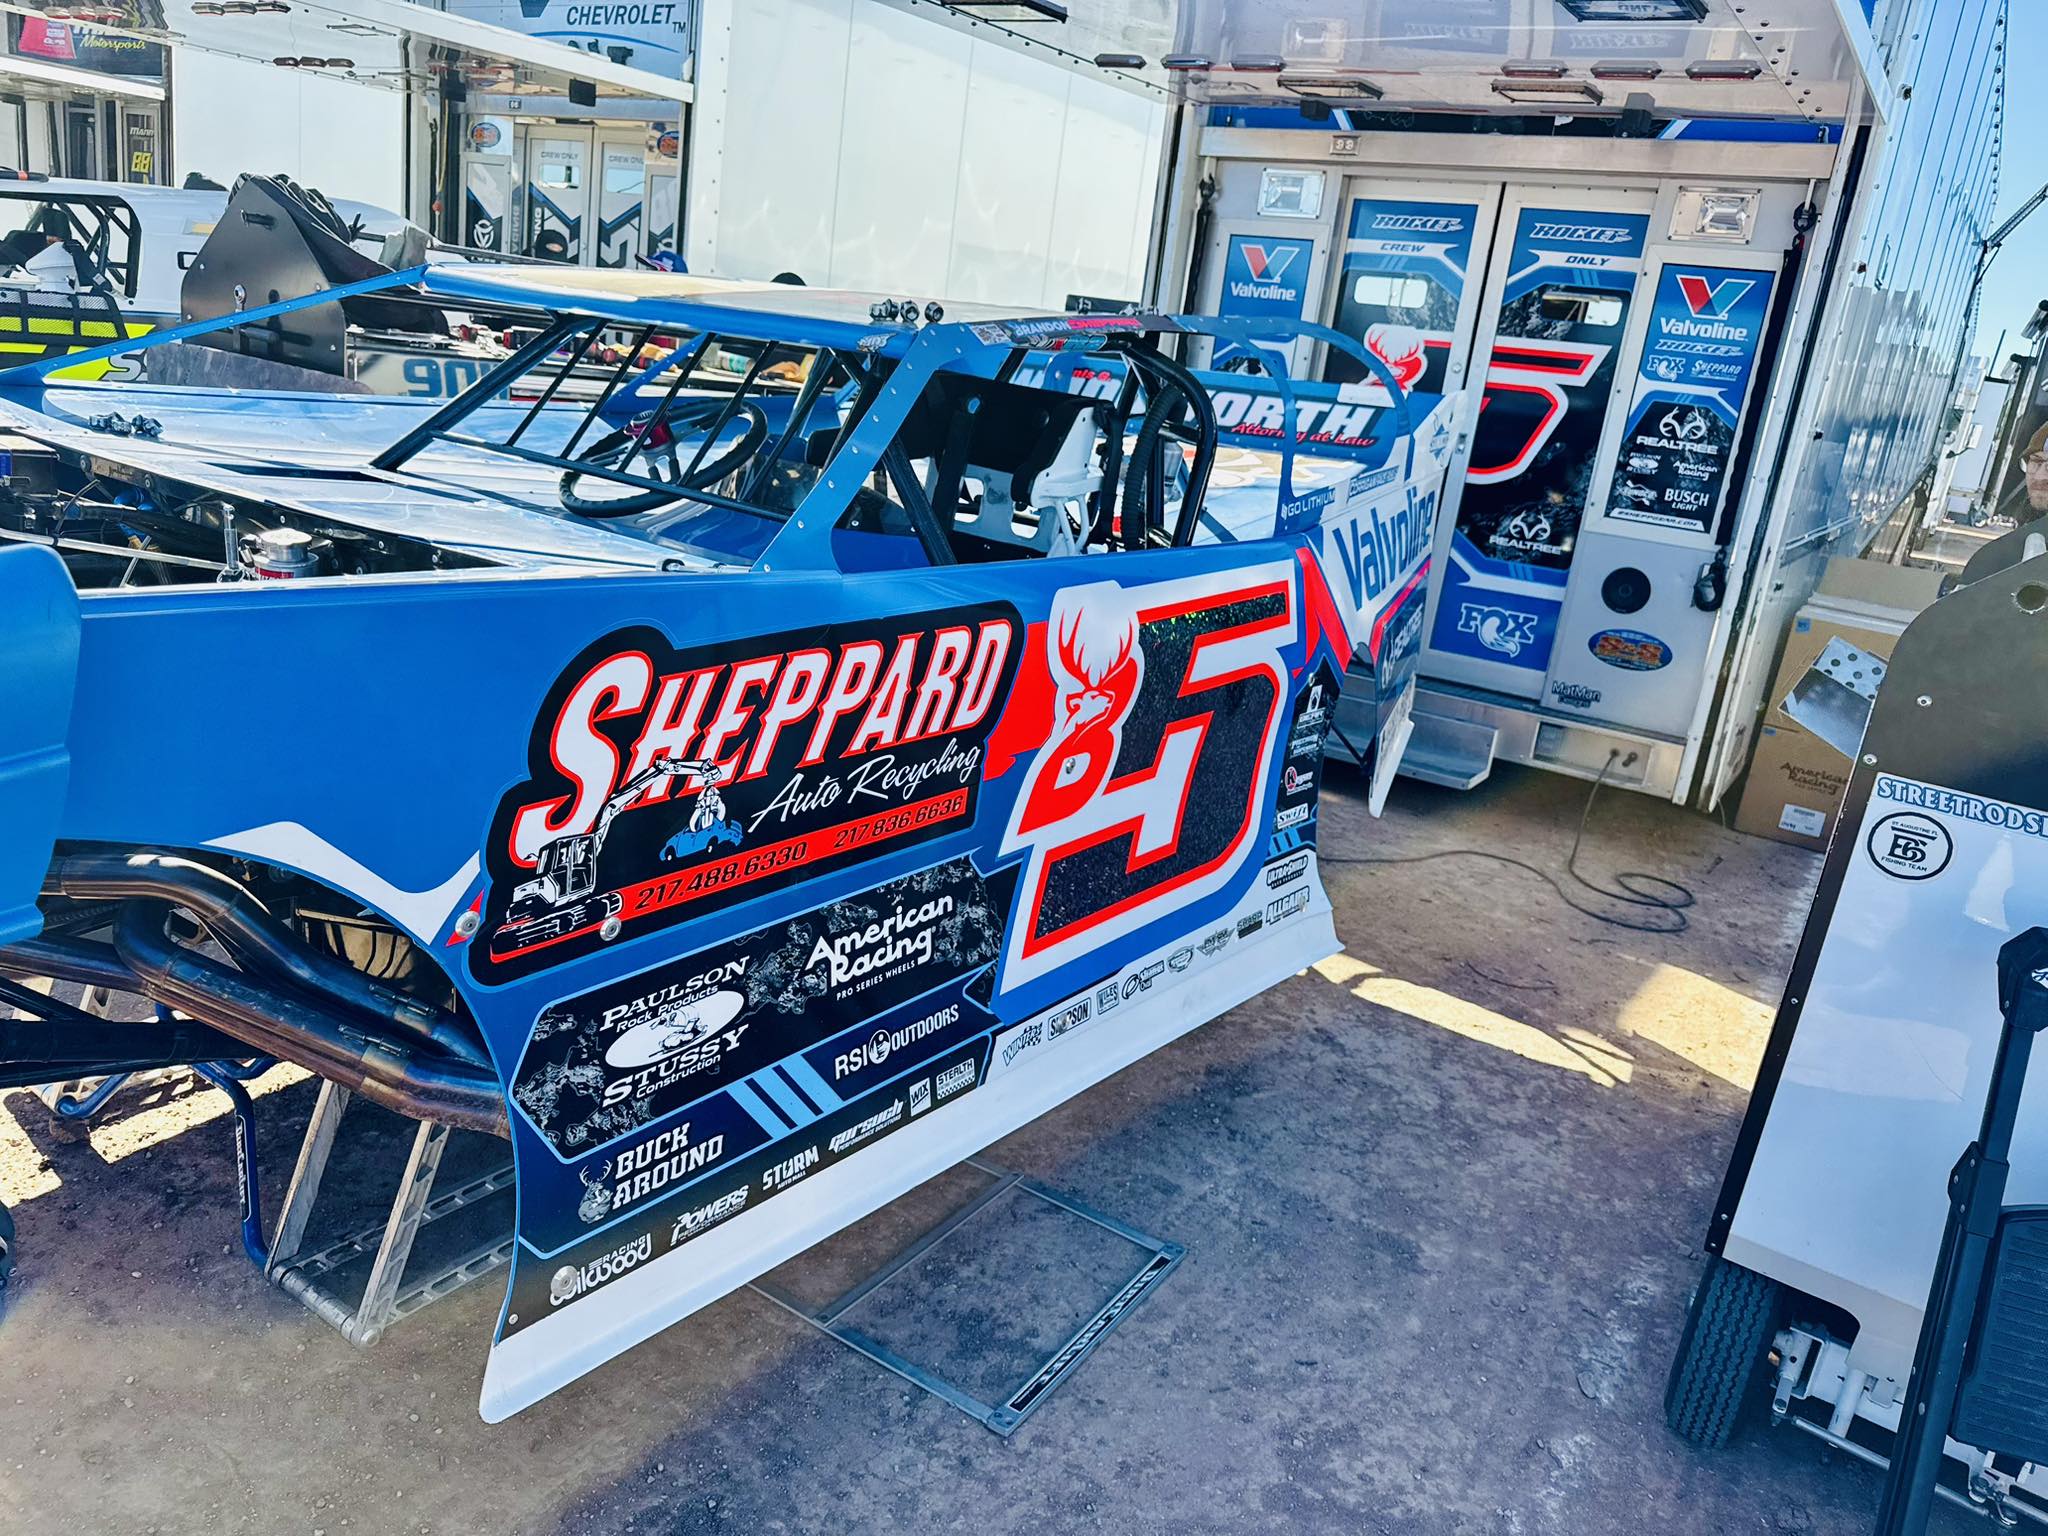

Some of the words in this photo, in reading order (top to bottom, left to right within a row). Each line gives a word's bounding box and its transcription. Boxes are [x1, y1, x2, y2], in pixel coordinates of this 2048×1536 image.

[566, 4, 676, 26] CHEVROLET
[131, 152, 151, 173] 88
[1380, 242, 1425, 252] CREW
[1529, 222, 1632, 244] ROCKET
[1565, 255, 1610, 266] ONLY
[1230, 282, 1297, 300] Valvoline
[1660, 317, 1749, 341] Valvoline
[1647, 355, 1685, 376] FOX
[1691, 359, 1743, 376] SHEPPARD
[1309, 431, 1329, 442] at
[1333, 433, 1378, 447] Law
[1635, 435, 1719, 455] REALTREE
[1672, 460, 1718, 473] American
[1286, 502, 1300, 517] GO
[1302, 487, 1336, 511] LITHIUM
[1664, 488, 1710, 507] BUSCH
[1671, 501, 1698, 511] LIGHT
[1331, 485, 1436, 612] Valvoline
[1488, 534, 1561, 555] REALTREE
[1457, 602, 1539, 650] FOX
[508, 617, 1014, 868] SHEPPARD
[746, 772, 843, 834] Auto
[846, 736, 981, 806] Recycling
[635, 840, 809, 911] 217.488.6330
[1907, 862, 1928, 872] TEAM
[804, 894, 954, 971] American
[830, 925, 937, 988] Racing
[599, 955, 750, 1032] PAULSON
[836, 987, 854, 1001] PRO
[855, 974, 884, 993] SERIES
[885, 960, 916, 978] WHEELS
[616, 1009, 654, 1034] Rock
[657, 984, 719, 1018] Products
[834, 1044, 868, 1081] RSI
[891, 1003, 960, 1052] OUTDOORS
[601, 1023, 749, 1108] STUSSY
[635, 1053, 722, 1099] Construction
[910, 1081, 930, 1104] WIX
[614, 1121, 691, 1180] BUCK
[611, 1133, 725, 1211] AROUND
[776, 1178, 792, 1191] AUTO
[791, 1170, 806, 1184] MALL
[670, 1184, 749, 1247] POWERS
[602, 1235, 646, 1263] RACING
